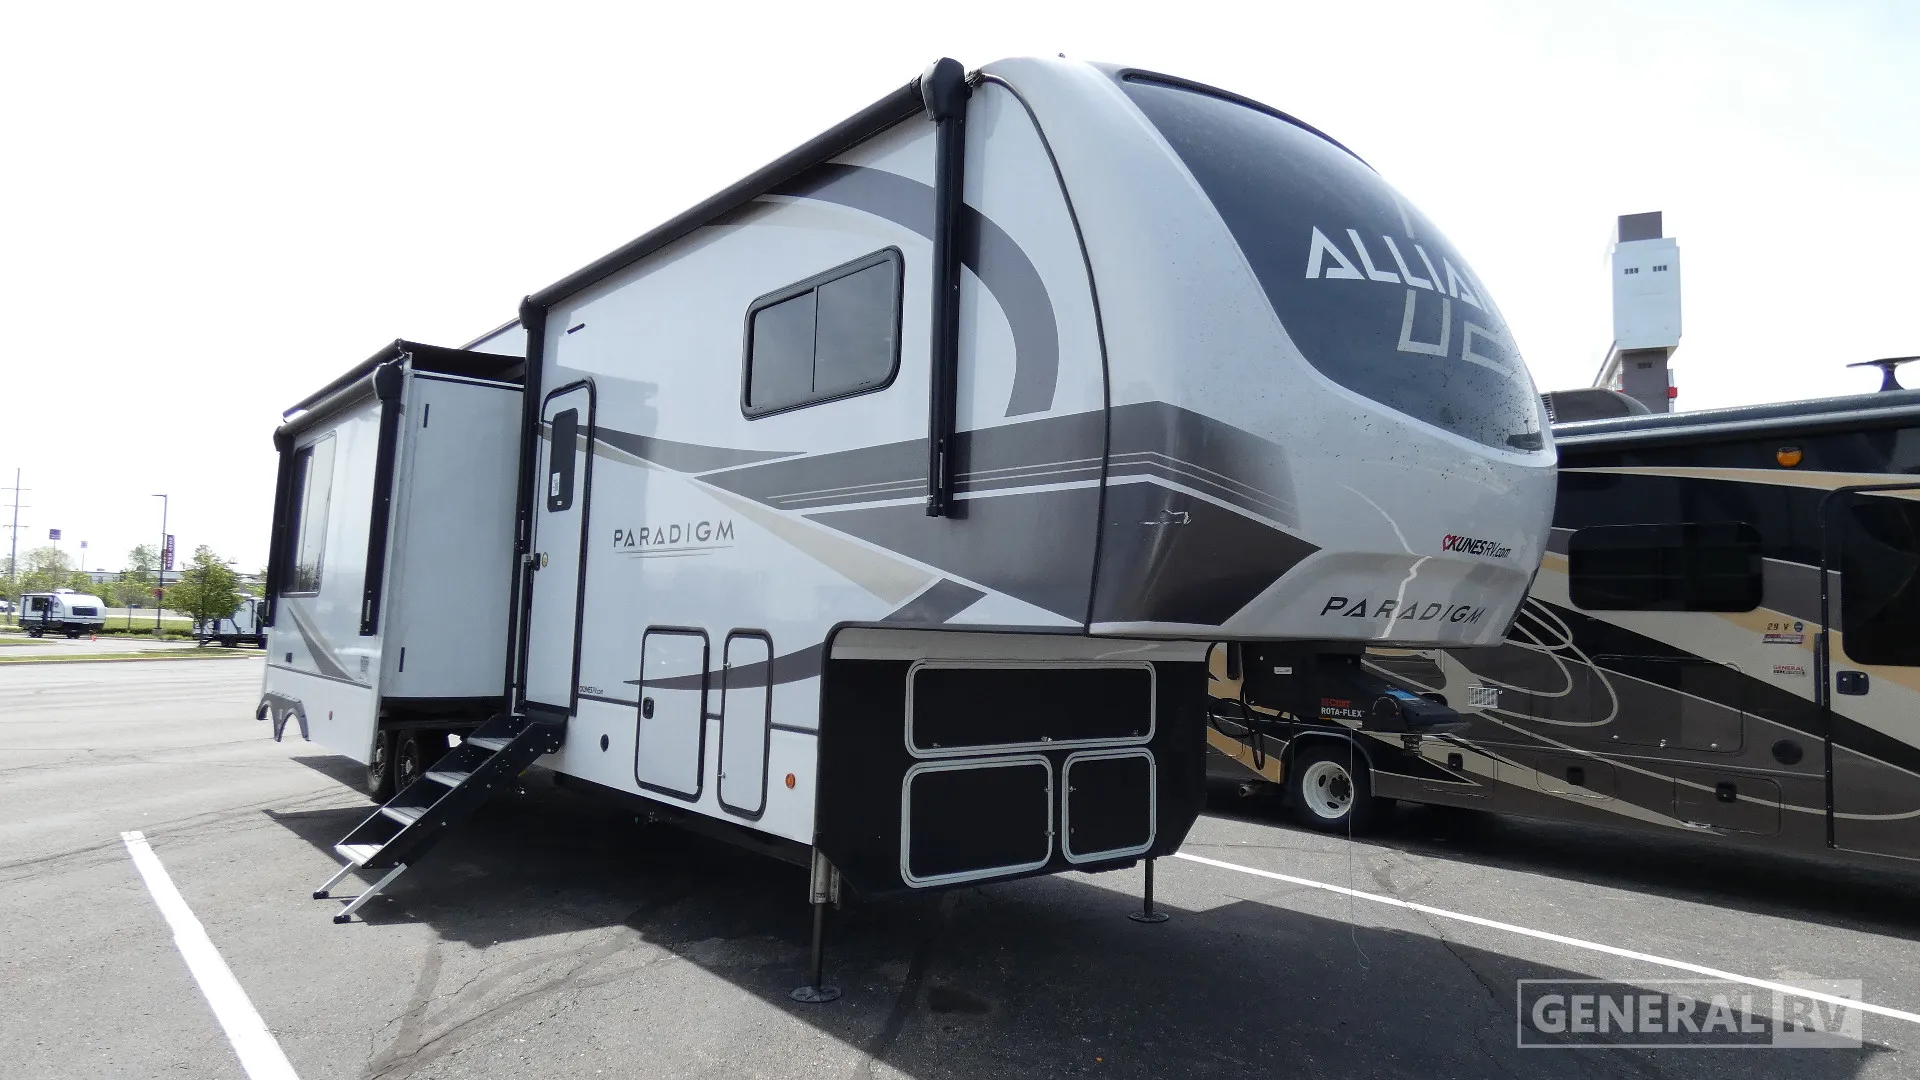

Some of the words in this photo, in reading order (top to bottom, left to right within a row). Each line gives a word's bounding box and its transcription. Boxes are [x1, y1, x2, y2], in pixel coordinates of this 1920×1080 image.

[613, 520, 735, 547] PARADIGM
[1320, 596, 1486, 624] PARADIGM
[1321, 706, 1362, 718] ROTA-FLEX
